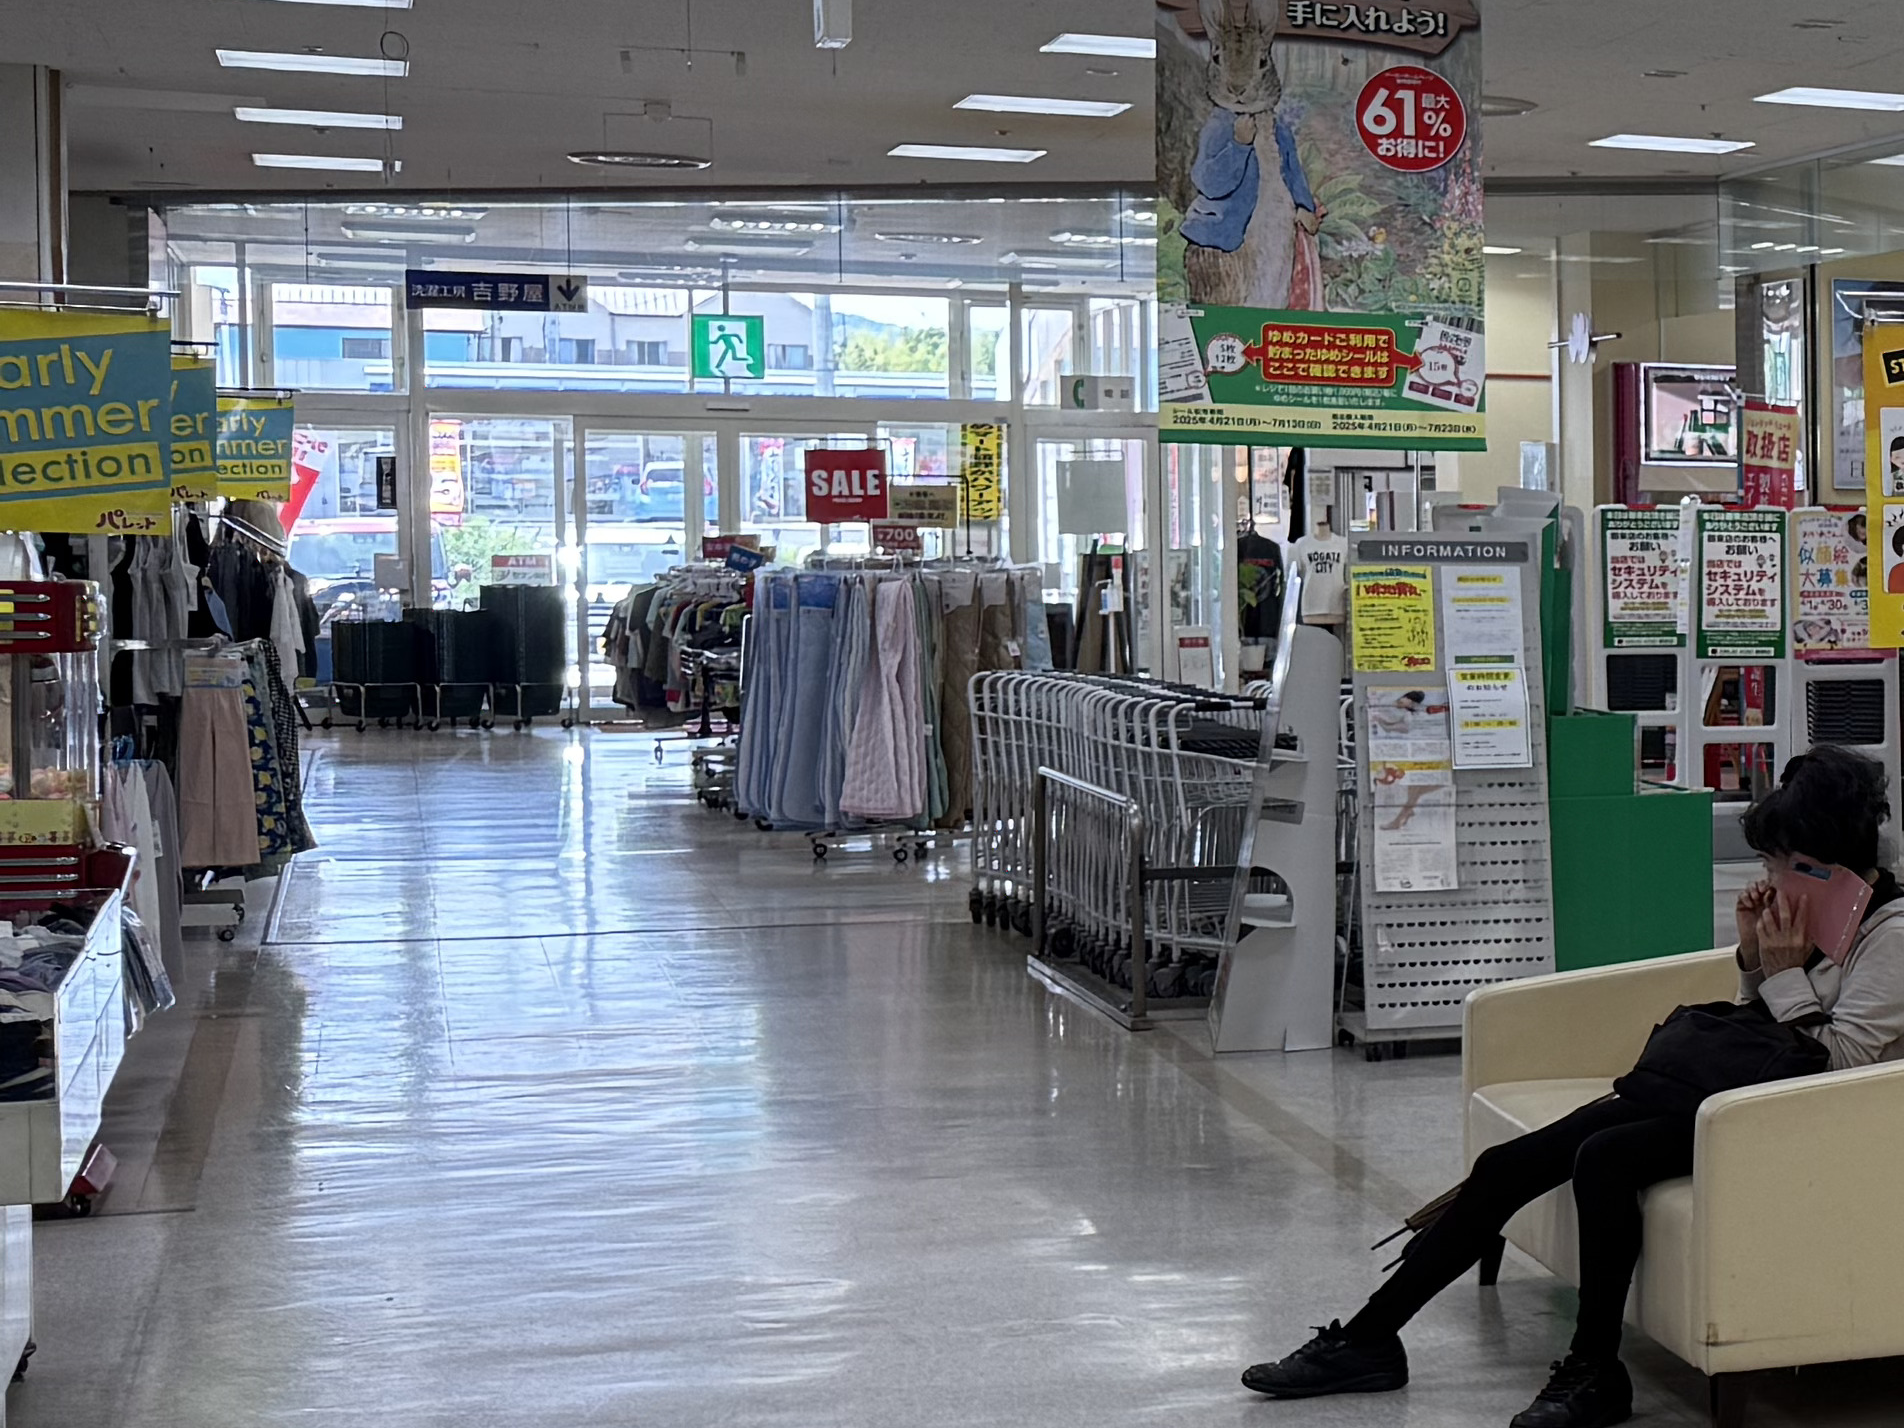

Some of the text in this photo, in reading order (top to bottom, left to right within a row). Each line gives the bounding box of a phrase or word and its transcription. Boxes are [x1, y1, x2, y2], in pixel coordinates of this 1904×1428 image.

[1287, 0, 1447, 37] 手に入れよう!
[1421, 93, 1449, 110] 最大
[1377, 137, 1446, 159] お得に!
[471, 281, 545, 303] 吉野屋
[1267, 330, 1390, 348] ゆめカードご利用で
[1267, 345, 1390, 363] 貯まったゆめシールは
[0, 343, 113, 397] arly
[1269, 362, 1390, 379] ここで確認できます
[0, 398, 160, 443] mmer
[1745, 430, 1791, 464] 取扱店
[0, 450, 152, 486] lection
[811, 469, 881, 497] SALE
[96, 508, 156, 530] パレット
[1381, 544, 1507, 558] INFORMATION
[1725, 545, 1758, 556] お願い
[1315, 562, 1334, 573] CITY
[1706, 570, 1778, 583] セキュリティ
[1610, 578, 1668, 590] システムを
[1705, 583, 1765, 597] システムを
